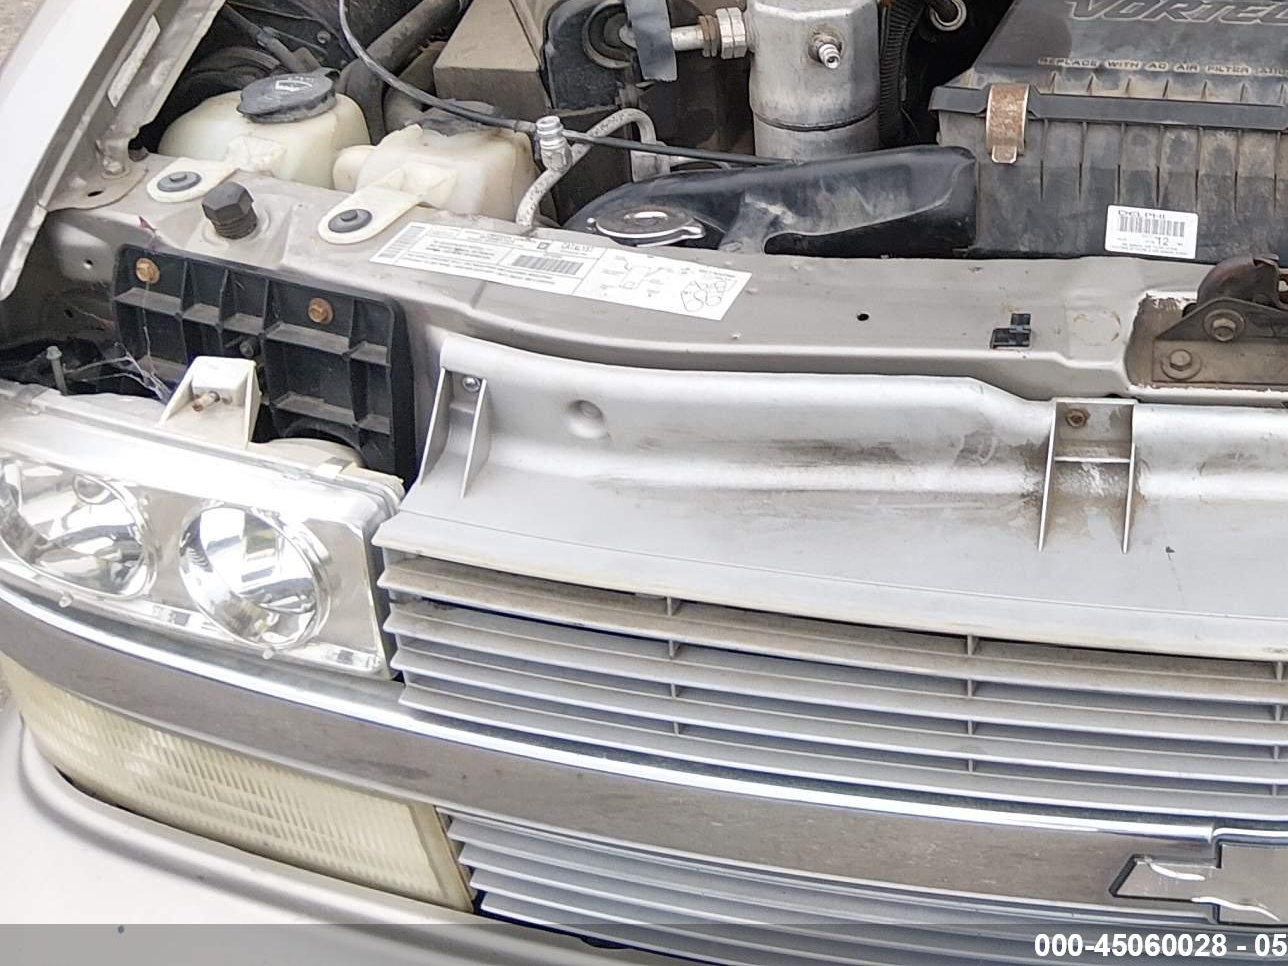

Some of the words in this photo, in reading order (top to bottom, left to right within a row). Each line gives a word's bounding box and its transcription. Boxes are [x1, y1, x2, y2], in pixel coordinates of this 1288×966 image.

[1039, 57, 1100, 68] REPLACE
[1106, 59, 1140, 70] WITH
[1177, 63, 1199, 72] AIR
[1206, 65, 1250, 74] FILTER
